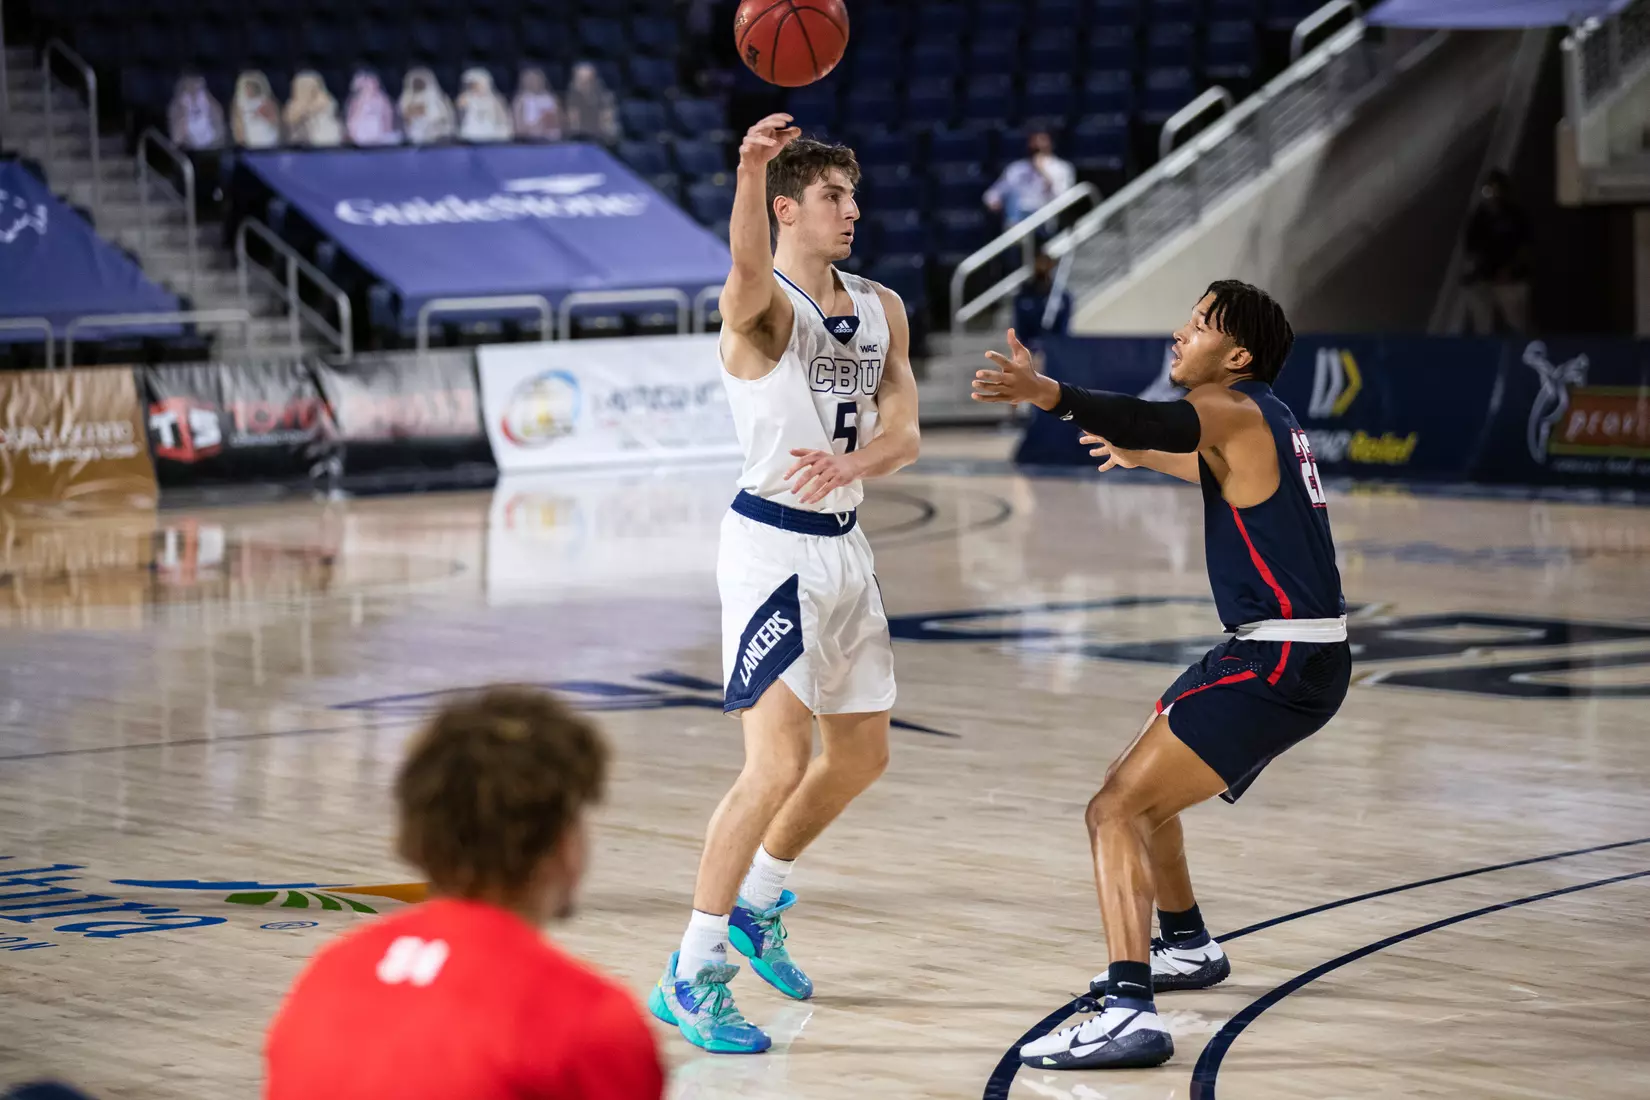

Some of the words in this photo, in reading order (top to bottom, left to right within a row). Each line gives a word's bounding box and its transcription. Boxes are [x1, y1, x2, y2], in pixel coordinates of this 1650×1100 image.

[860, 344, 878, 353] WAC
[809, 356, 881, 395] CBU
[832, 401, 858, 455] 5
[739, 610, 794, 687] LANCERS
